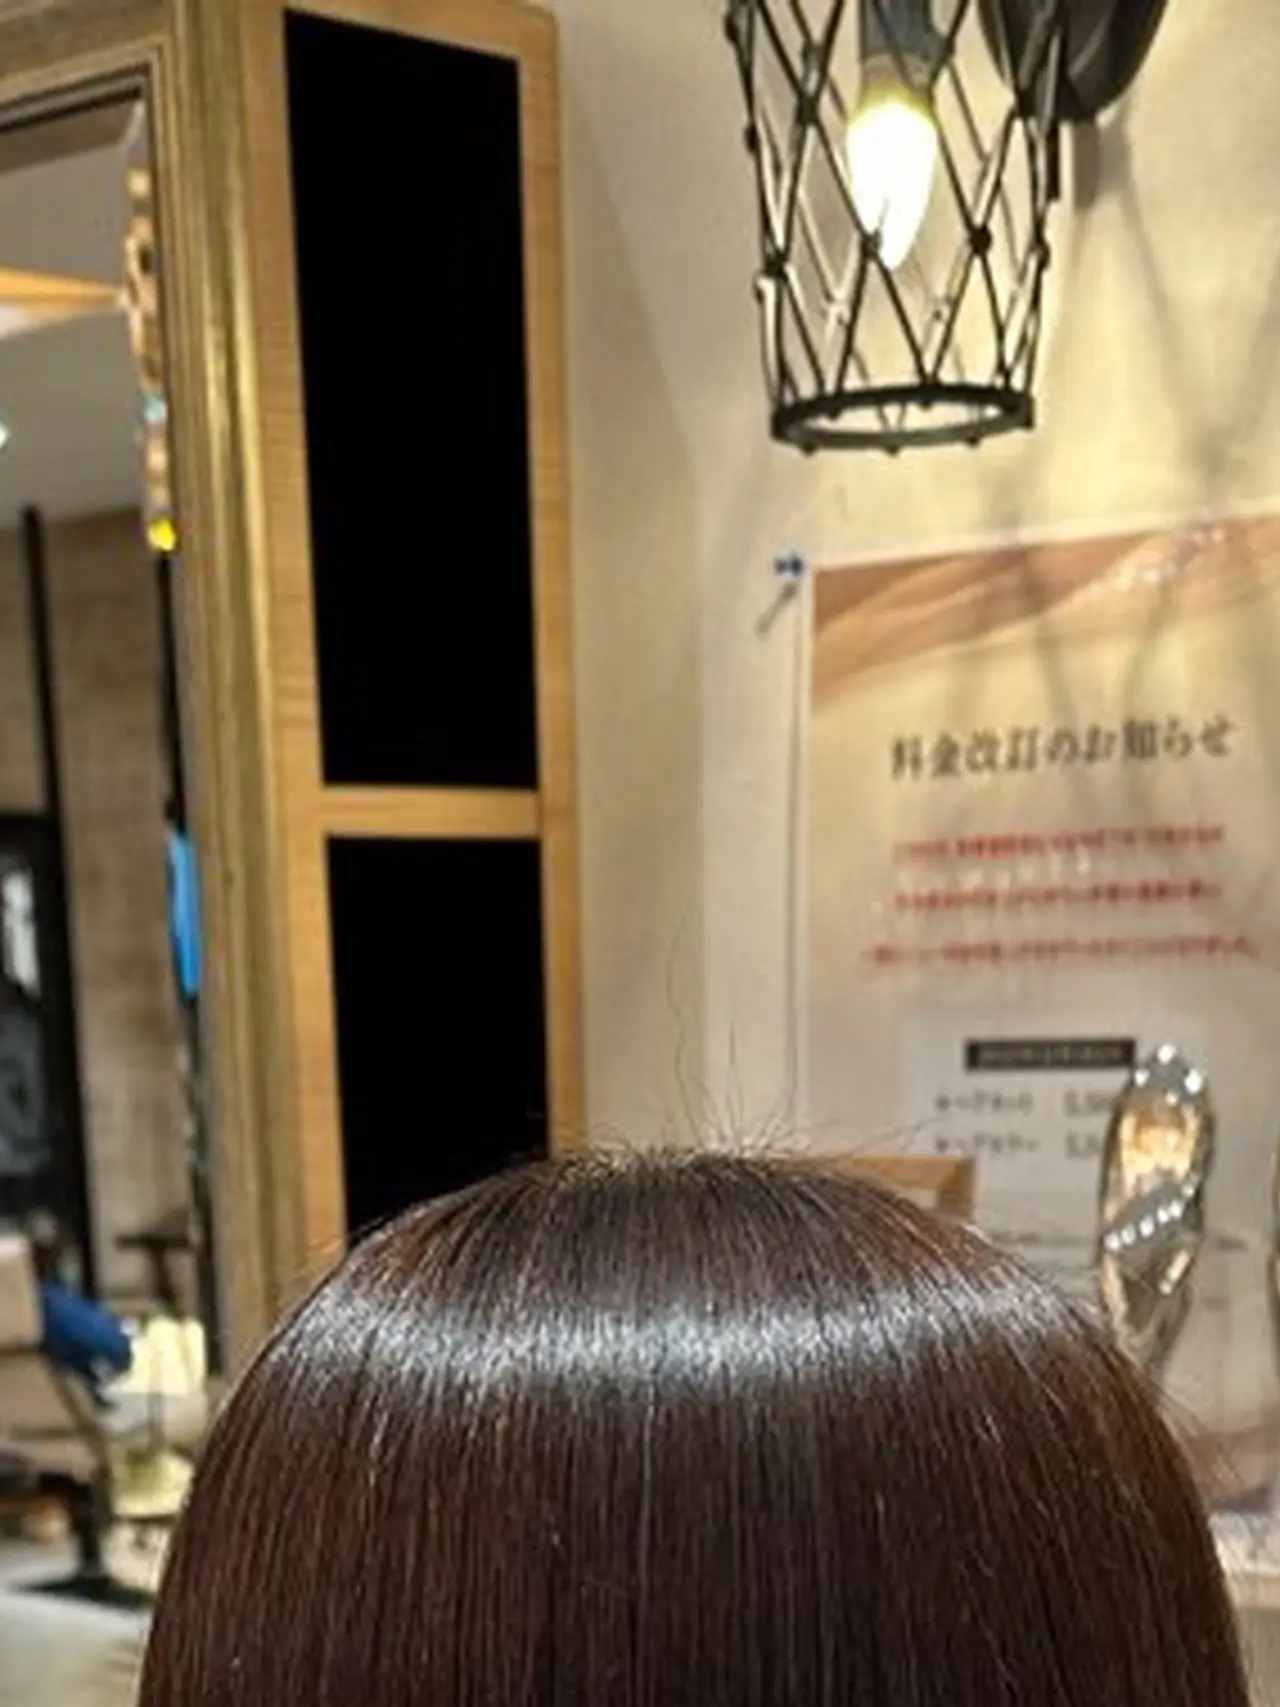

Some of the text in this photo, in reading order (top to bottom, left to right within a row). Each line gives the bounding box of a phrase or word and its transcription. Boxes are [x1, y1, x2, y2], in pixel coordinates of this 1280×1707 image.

[890, 716, 1235, 780] 料金改訂のお知らせ
